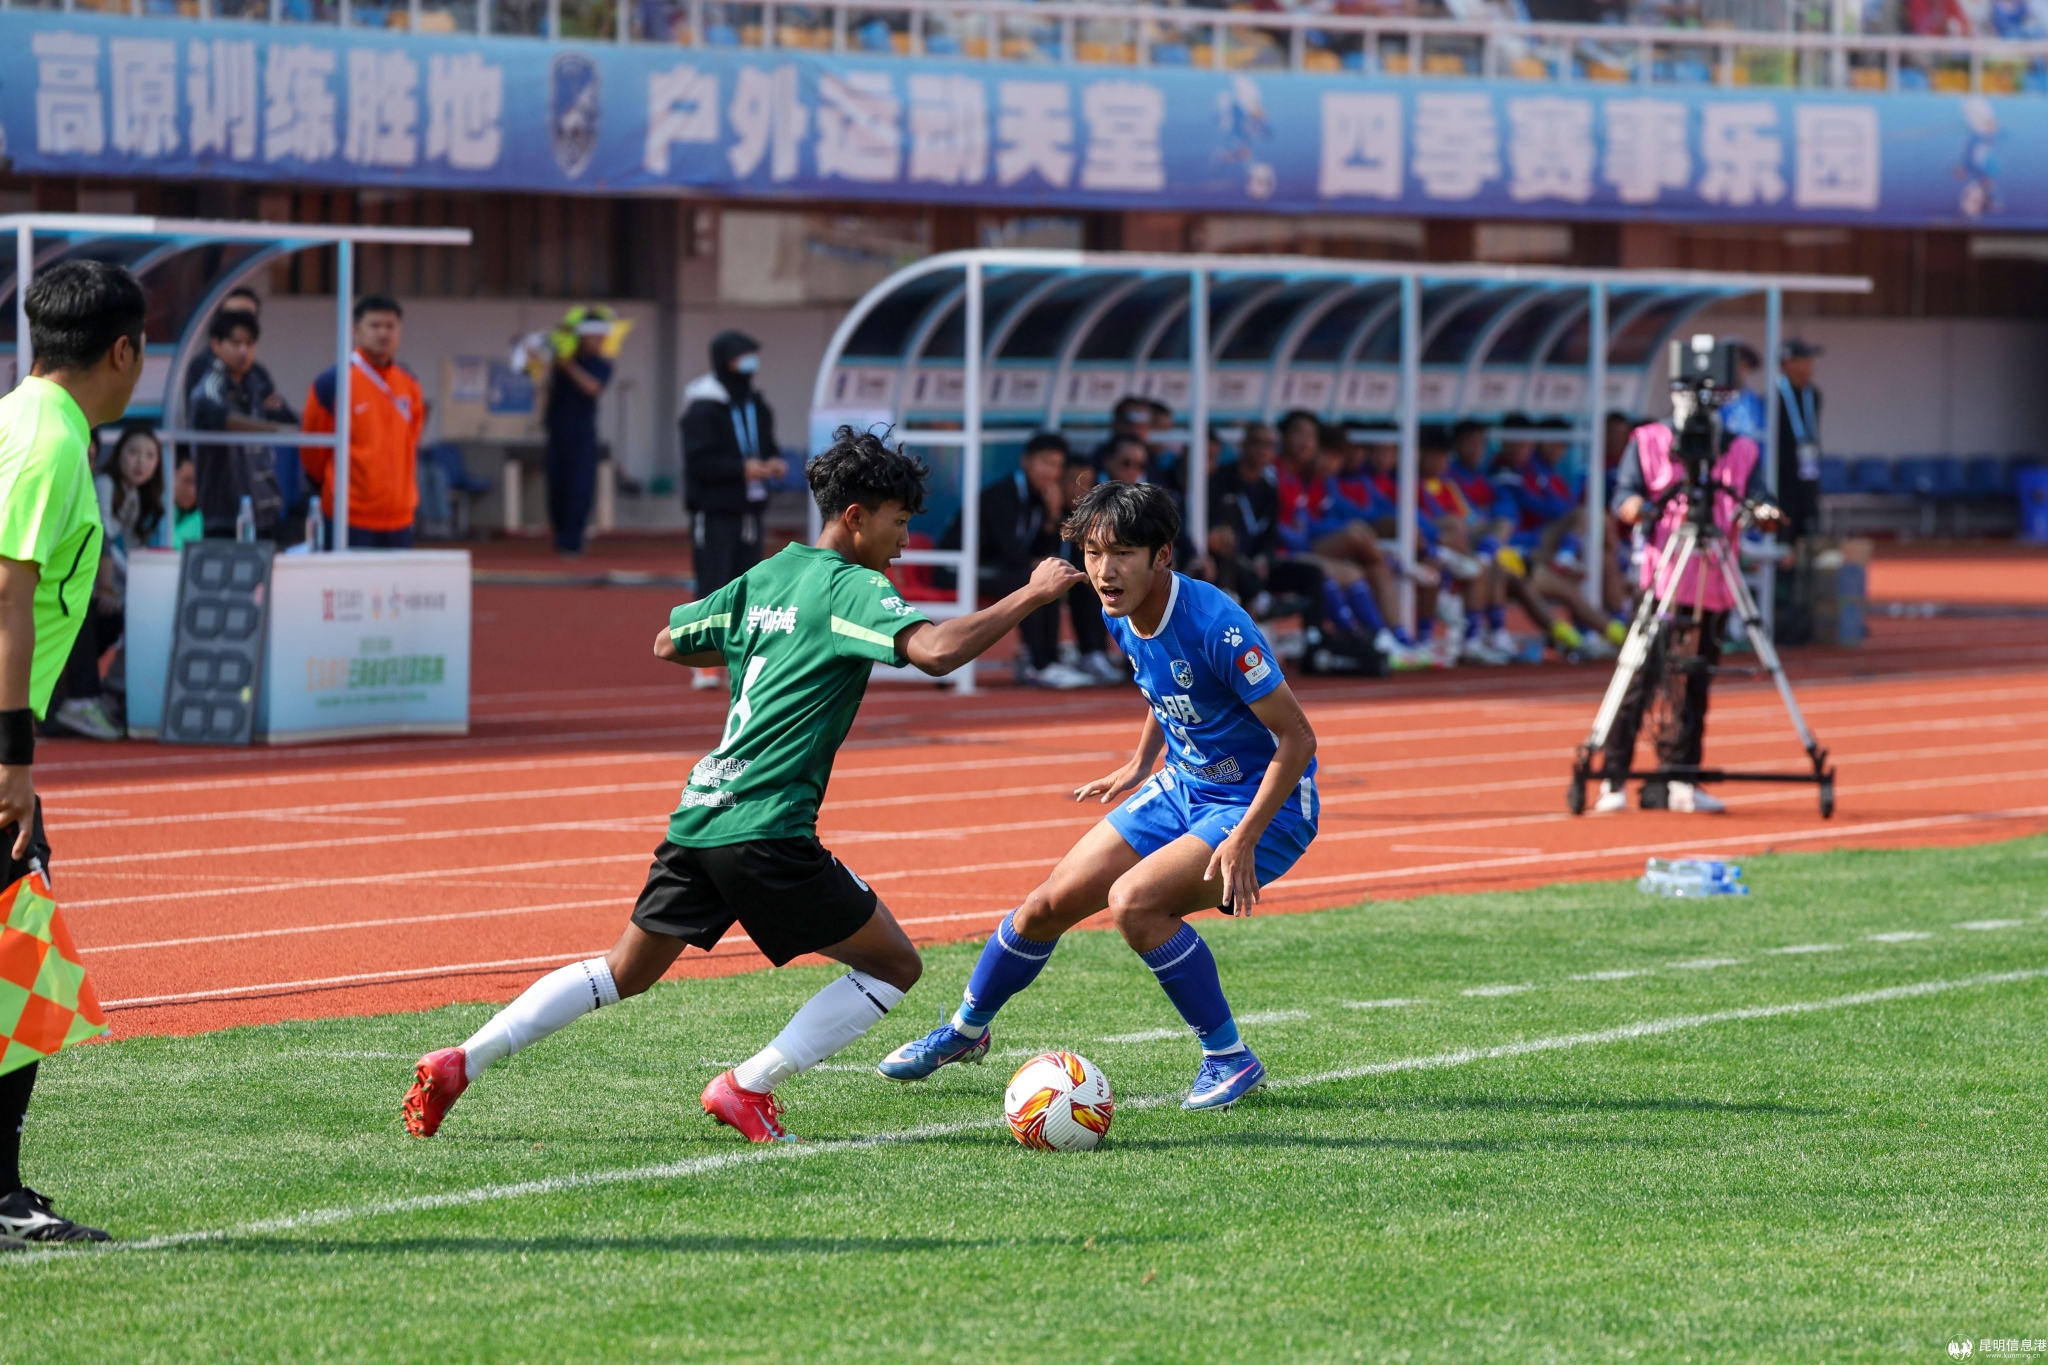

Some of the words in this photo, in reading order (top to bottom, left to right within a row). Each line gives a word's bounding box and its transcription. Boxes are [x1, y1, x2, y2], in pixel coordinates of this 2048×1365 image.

[32, 30, 503, 170] 高原训练胜地
[643, 63, 1167, 192] 户外运动天堂
[1319, 92, 1881, 210] 四季赛事乐园
[715, 656, 768, 755] 6
[846, 972, 867, 993] LME
